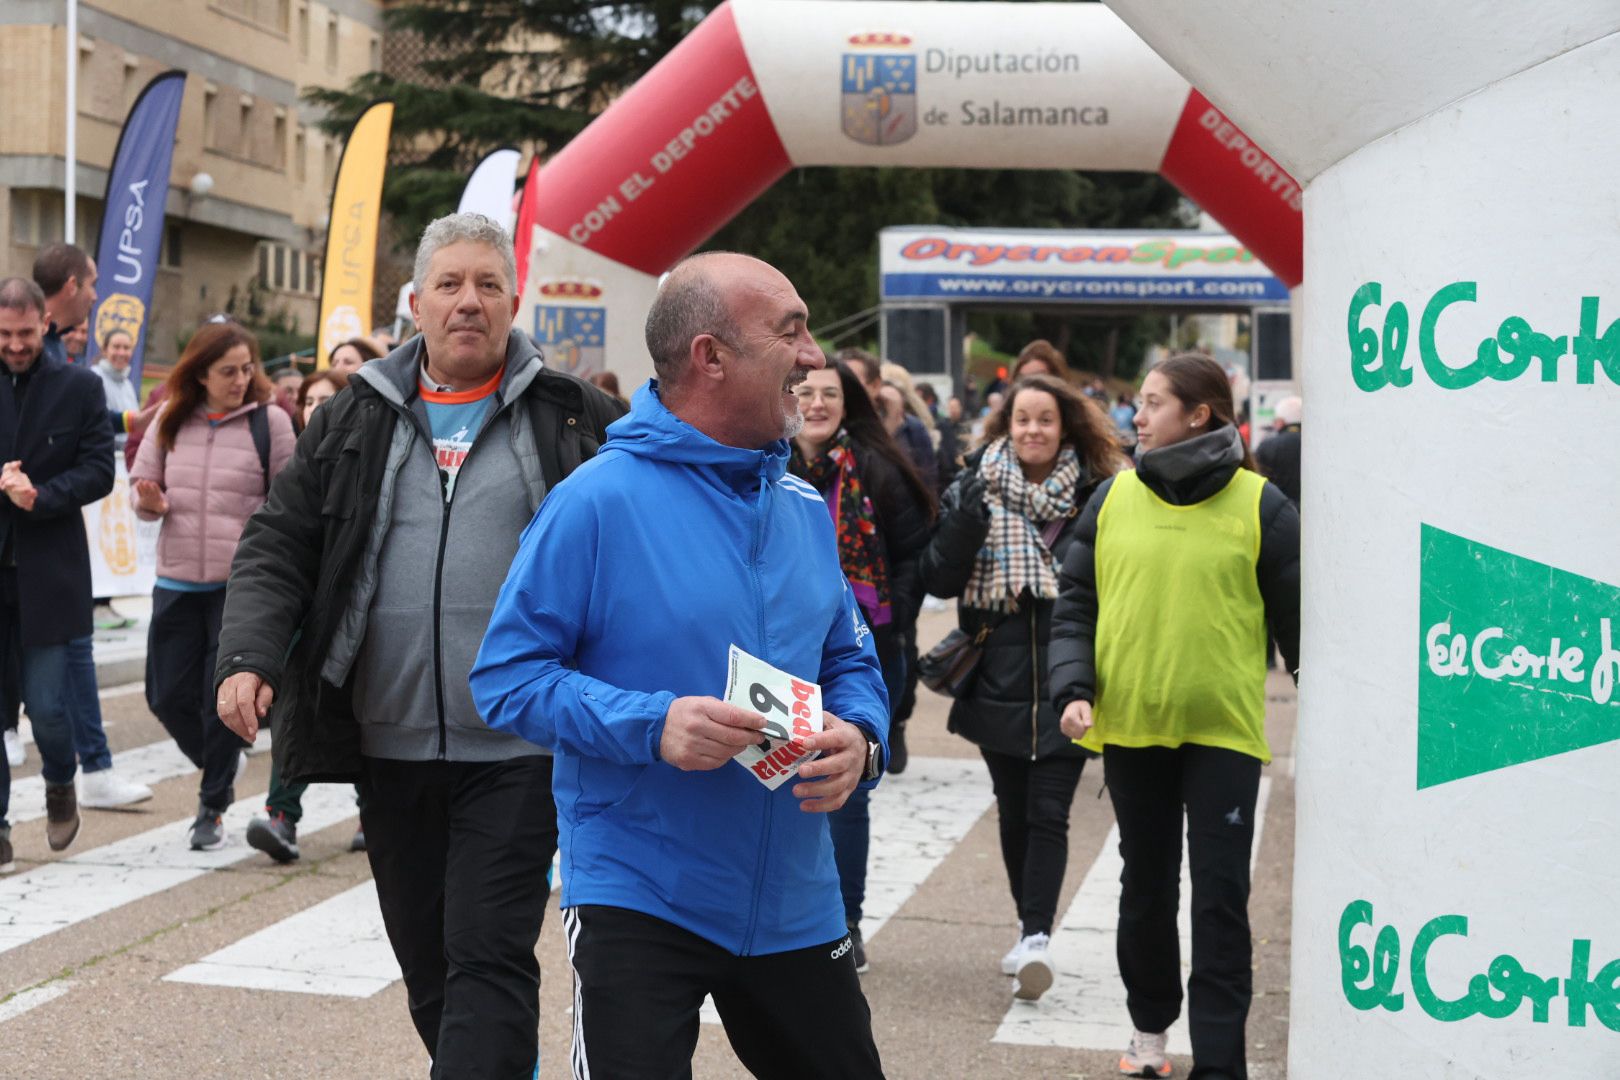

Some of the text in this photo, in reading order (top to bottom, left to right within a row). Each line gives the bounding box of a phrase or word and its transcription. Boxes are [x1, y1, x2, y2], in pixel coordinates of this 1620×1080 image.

[925, 47, 1080, 79] Diputación
[923, 99, 1109, 126] de Salamanca
[569, 74, 758, 245] CON EL DEPORTE
[113, 179, 149, 285] UPSA
[938, 275, 1264, 297] www.orycronsport.com
[1347, 281, 1413, 393] El
[1426, 622, 1469, 677] El
[1471, 626, 1585, 683] Corte
[1338, 899, 1404, 1012] El
